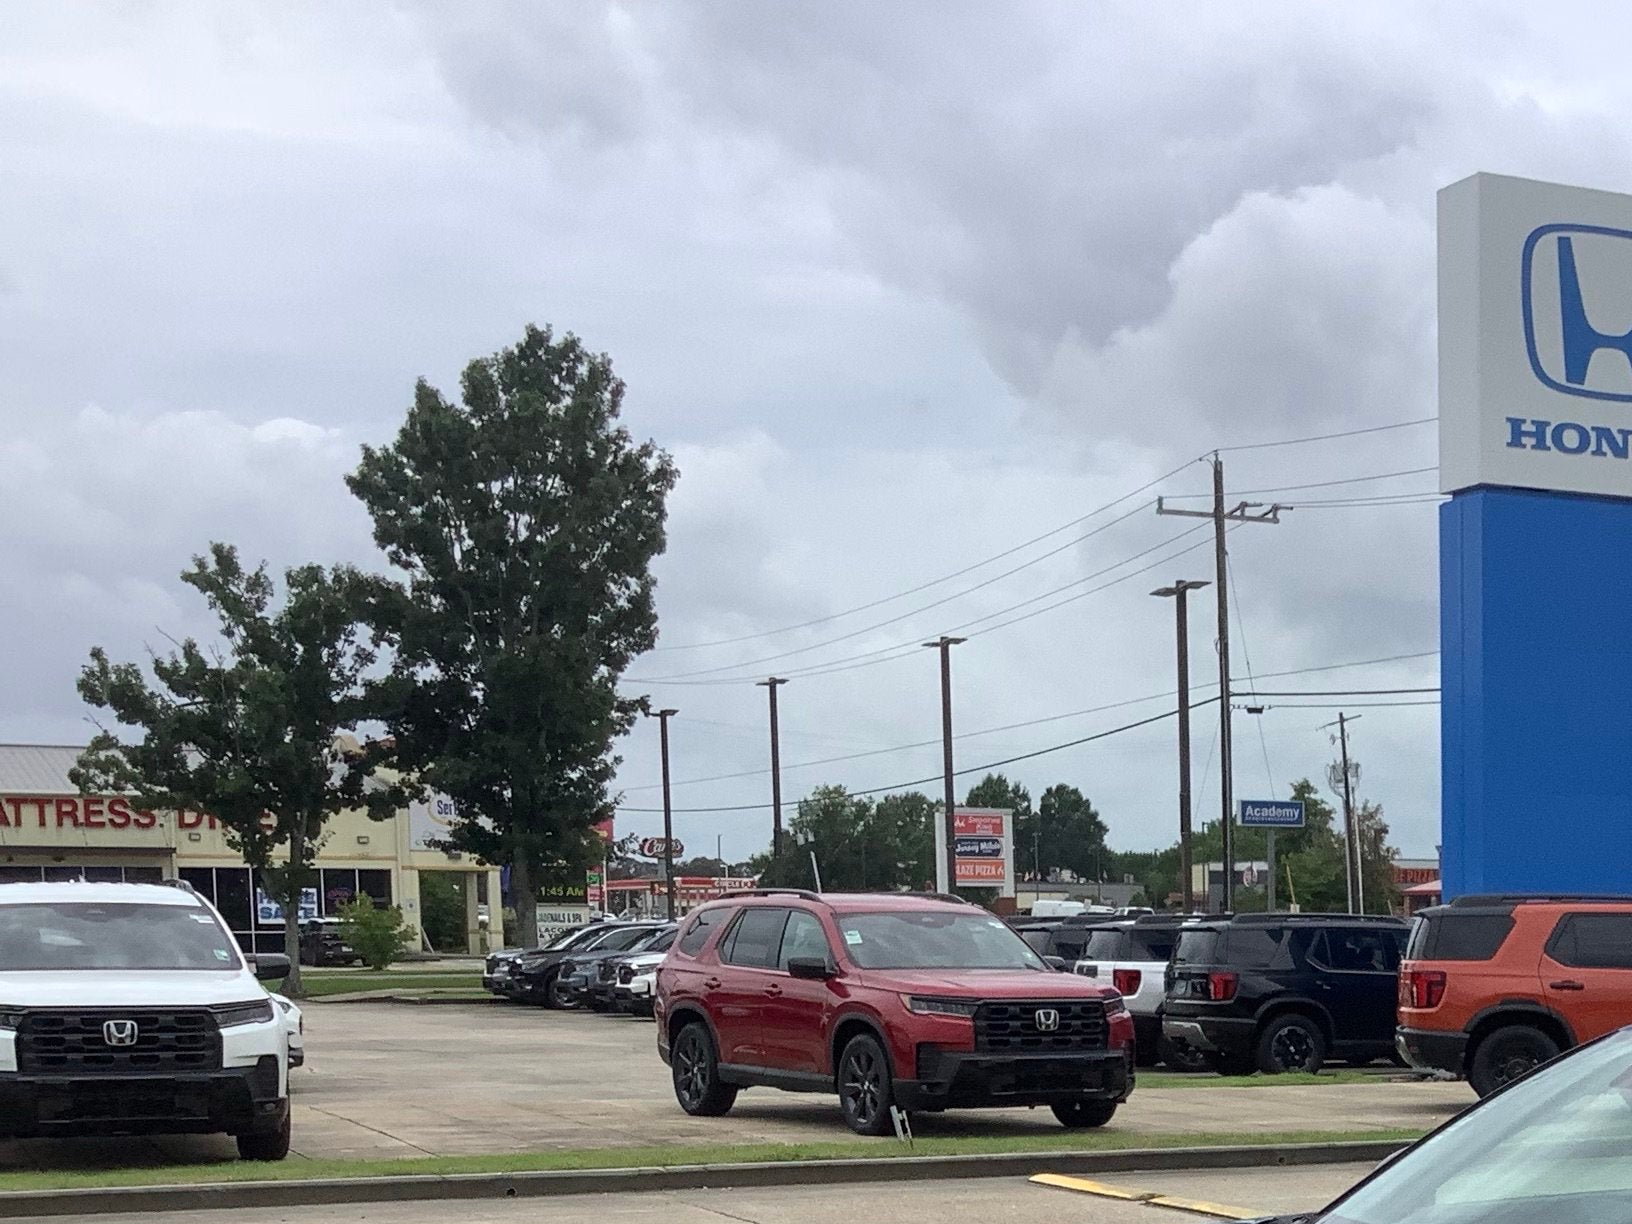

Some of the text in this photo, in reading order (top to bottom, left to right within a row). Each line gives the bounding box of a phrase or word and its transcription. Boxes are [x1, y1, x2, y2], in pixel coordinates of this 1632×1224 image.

[1245, 806, 1300, 820] Academy
[956, 865, 996, 875] LAZE PIZZA
[260, 906, 315, 919] SAE
